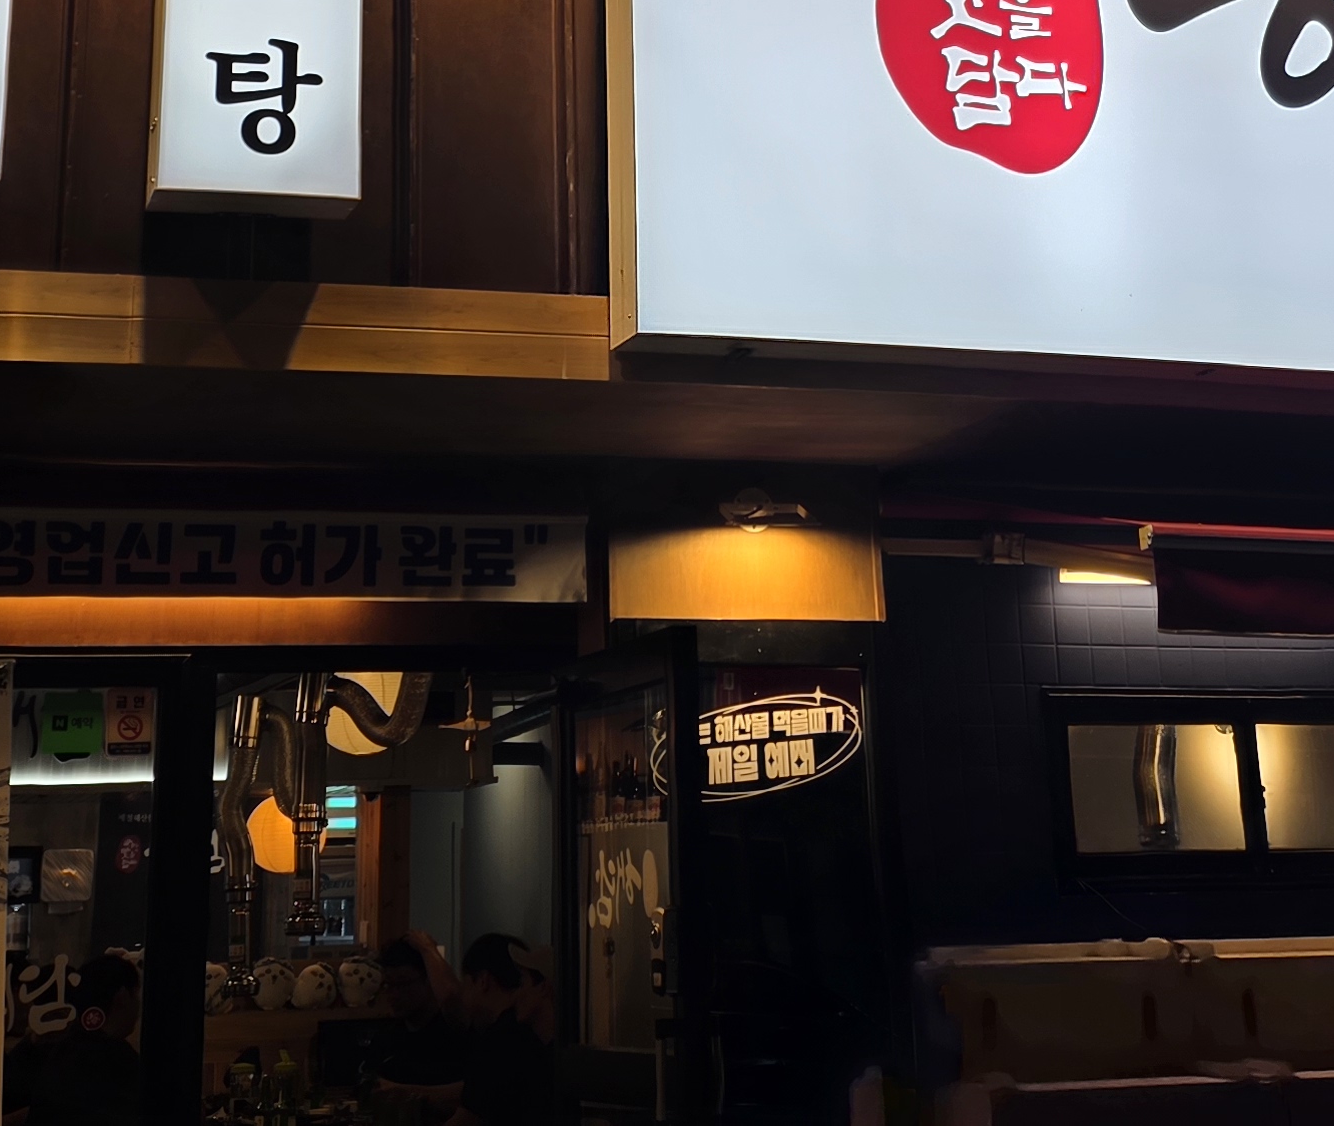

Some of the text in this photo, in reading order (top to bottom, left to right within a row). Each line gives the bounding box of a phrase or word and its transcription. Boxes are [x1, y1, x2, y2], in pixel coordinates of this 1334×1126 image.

[942, 46, 1087, 130] 담다
[260, 521, 381, 587] 허가
[714, 712, 769, 743] 해산물
[707, 744, 759, 785] 제일
